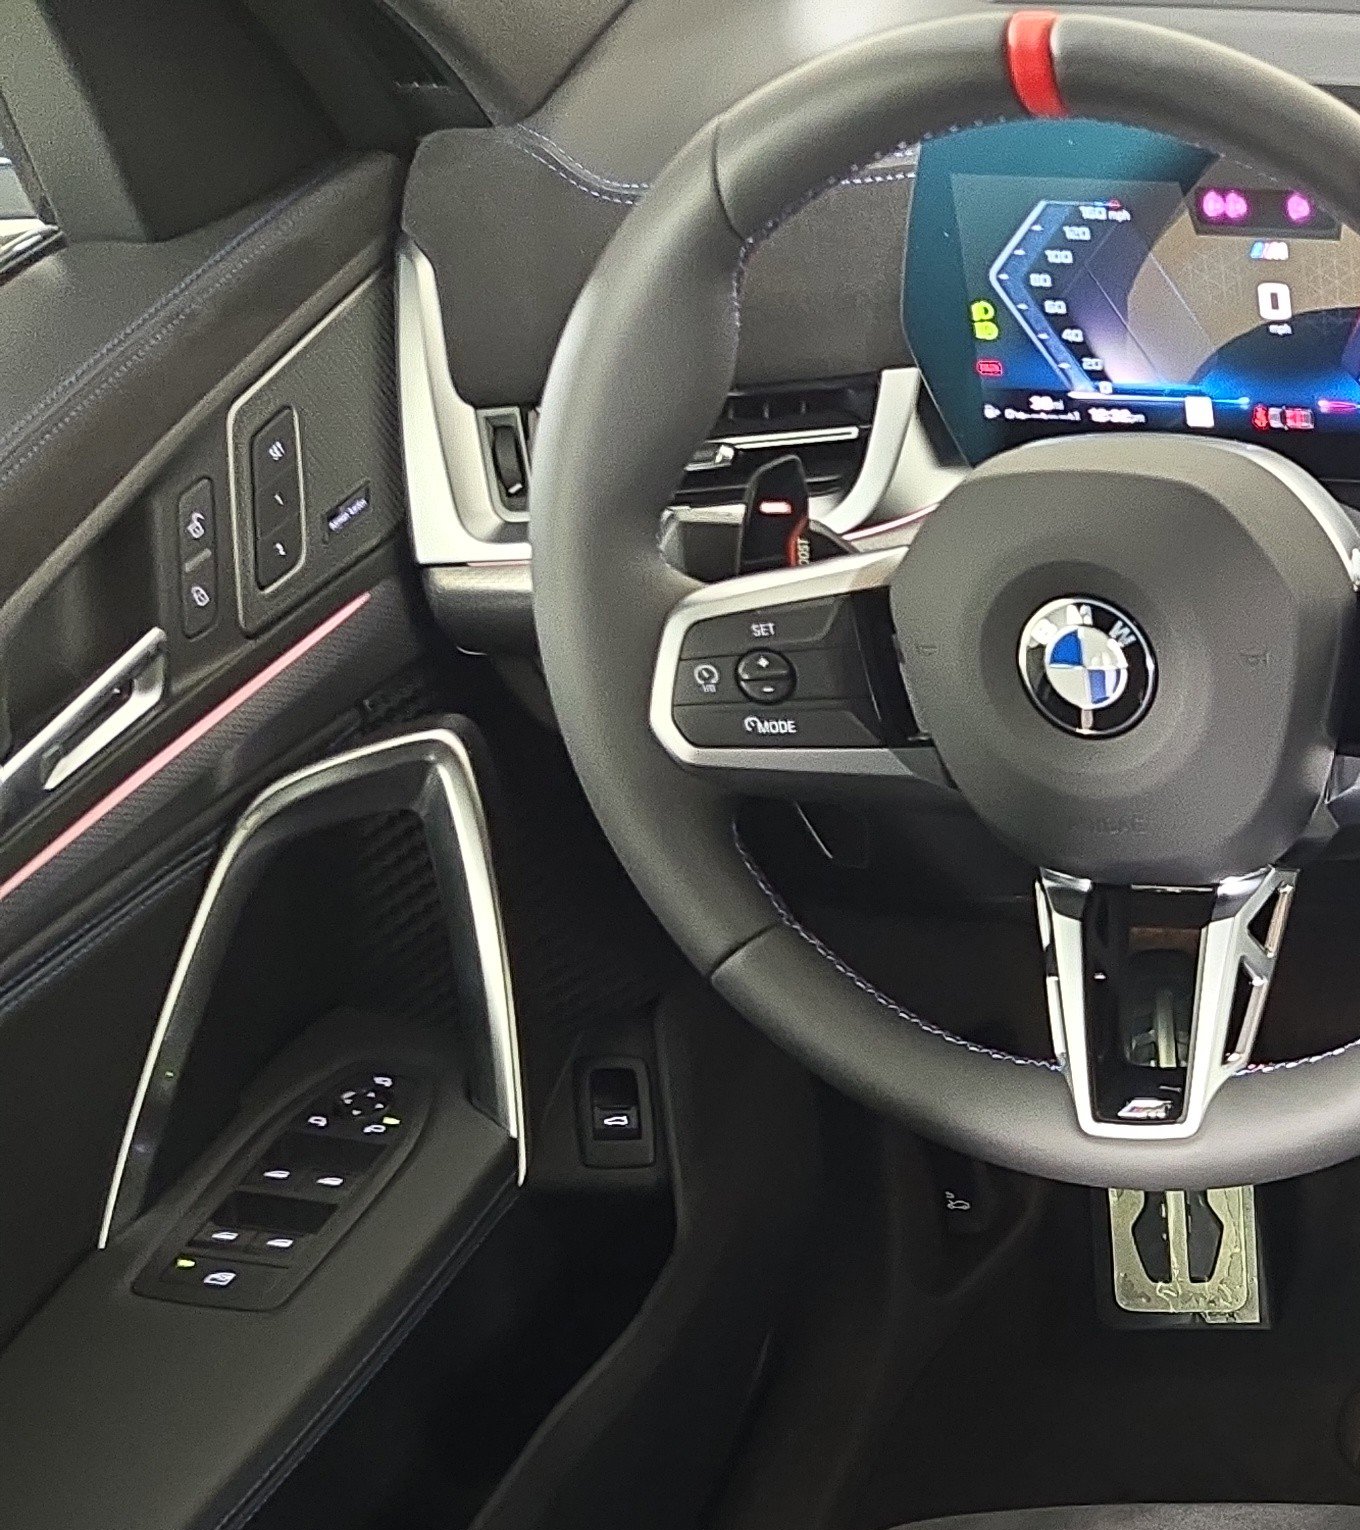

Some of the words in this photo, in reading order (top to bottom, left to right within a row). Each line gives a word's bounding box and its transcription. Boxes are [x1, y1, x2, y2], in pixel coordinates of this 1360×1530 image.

[1257, 282, 1292, 321] 0
[751, 622, 775, 637] SET
[757, 720, 796, 733] MODE
